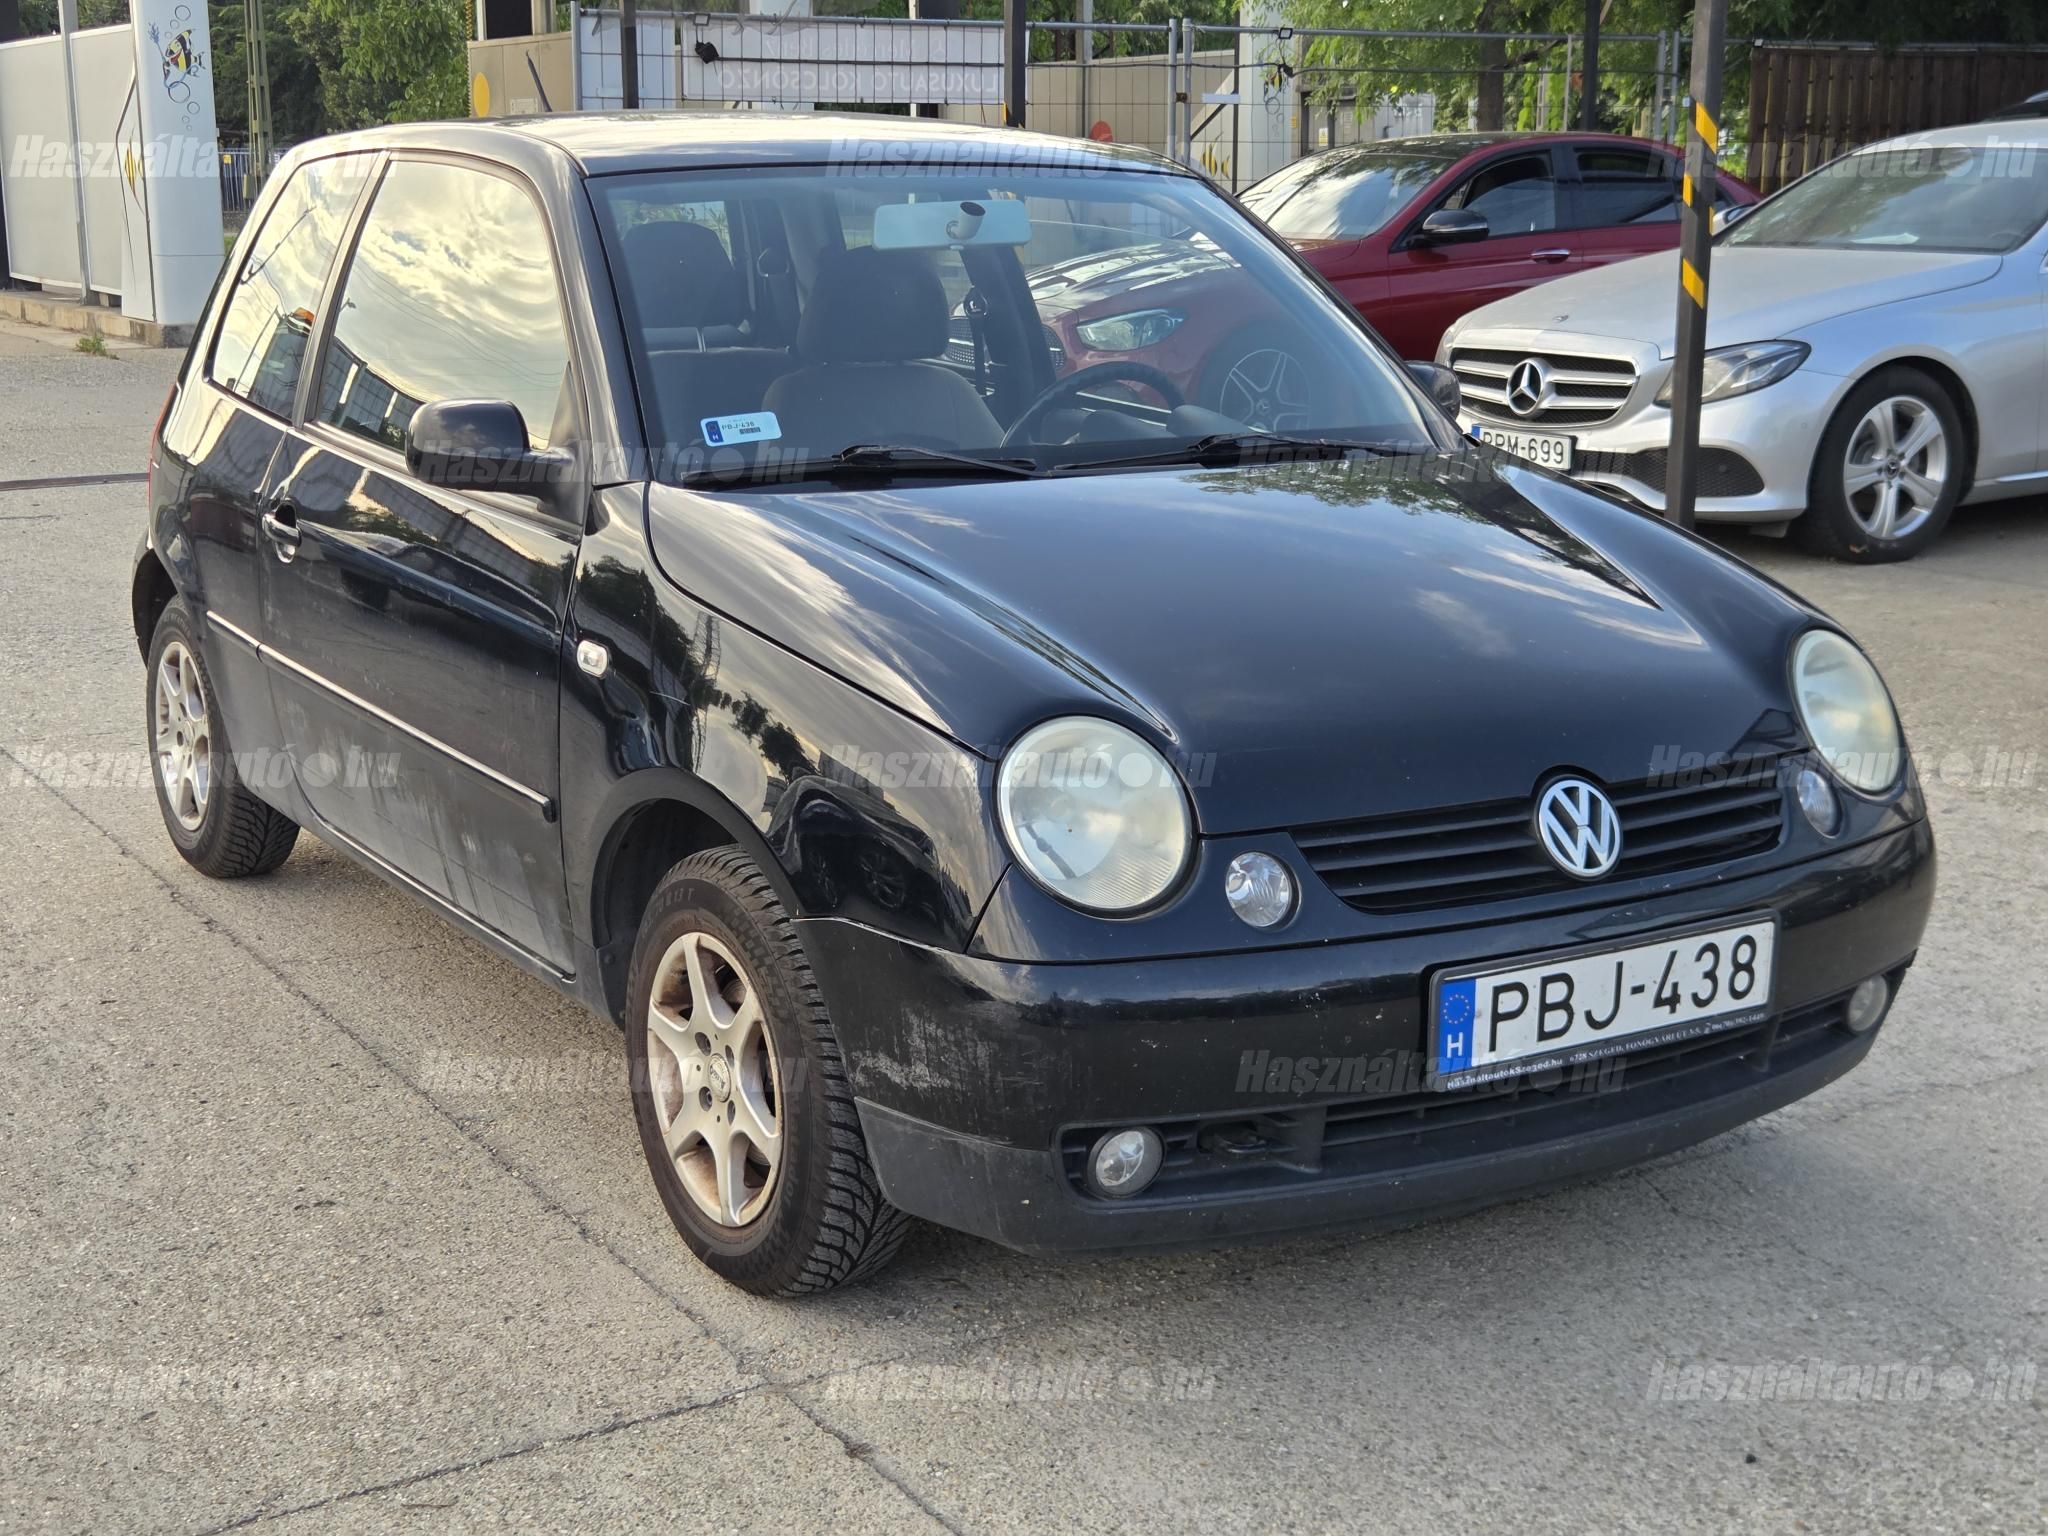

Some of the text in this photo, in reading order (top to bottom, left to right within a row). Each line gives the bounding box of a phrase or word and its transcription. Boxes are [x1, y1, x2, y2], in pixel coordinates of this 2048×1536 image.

[1539, 779, 1620, 877] VW
[1488, 934, 1757, 1053] PBJ-438
[1446, 1031, 1464, 1058] H
